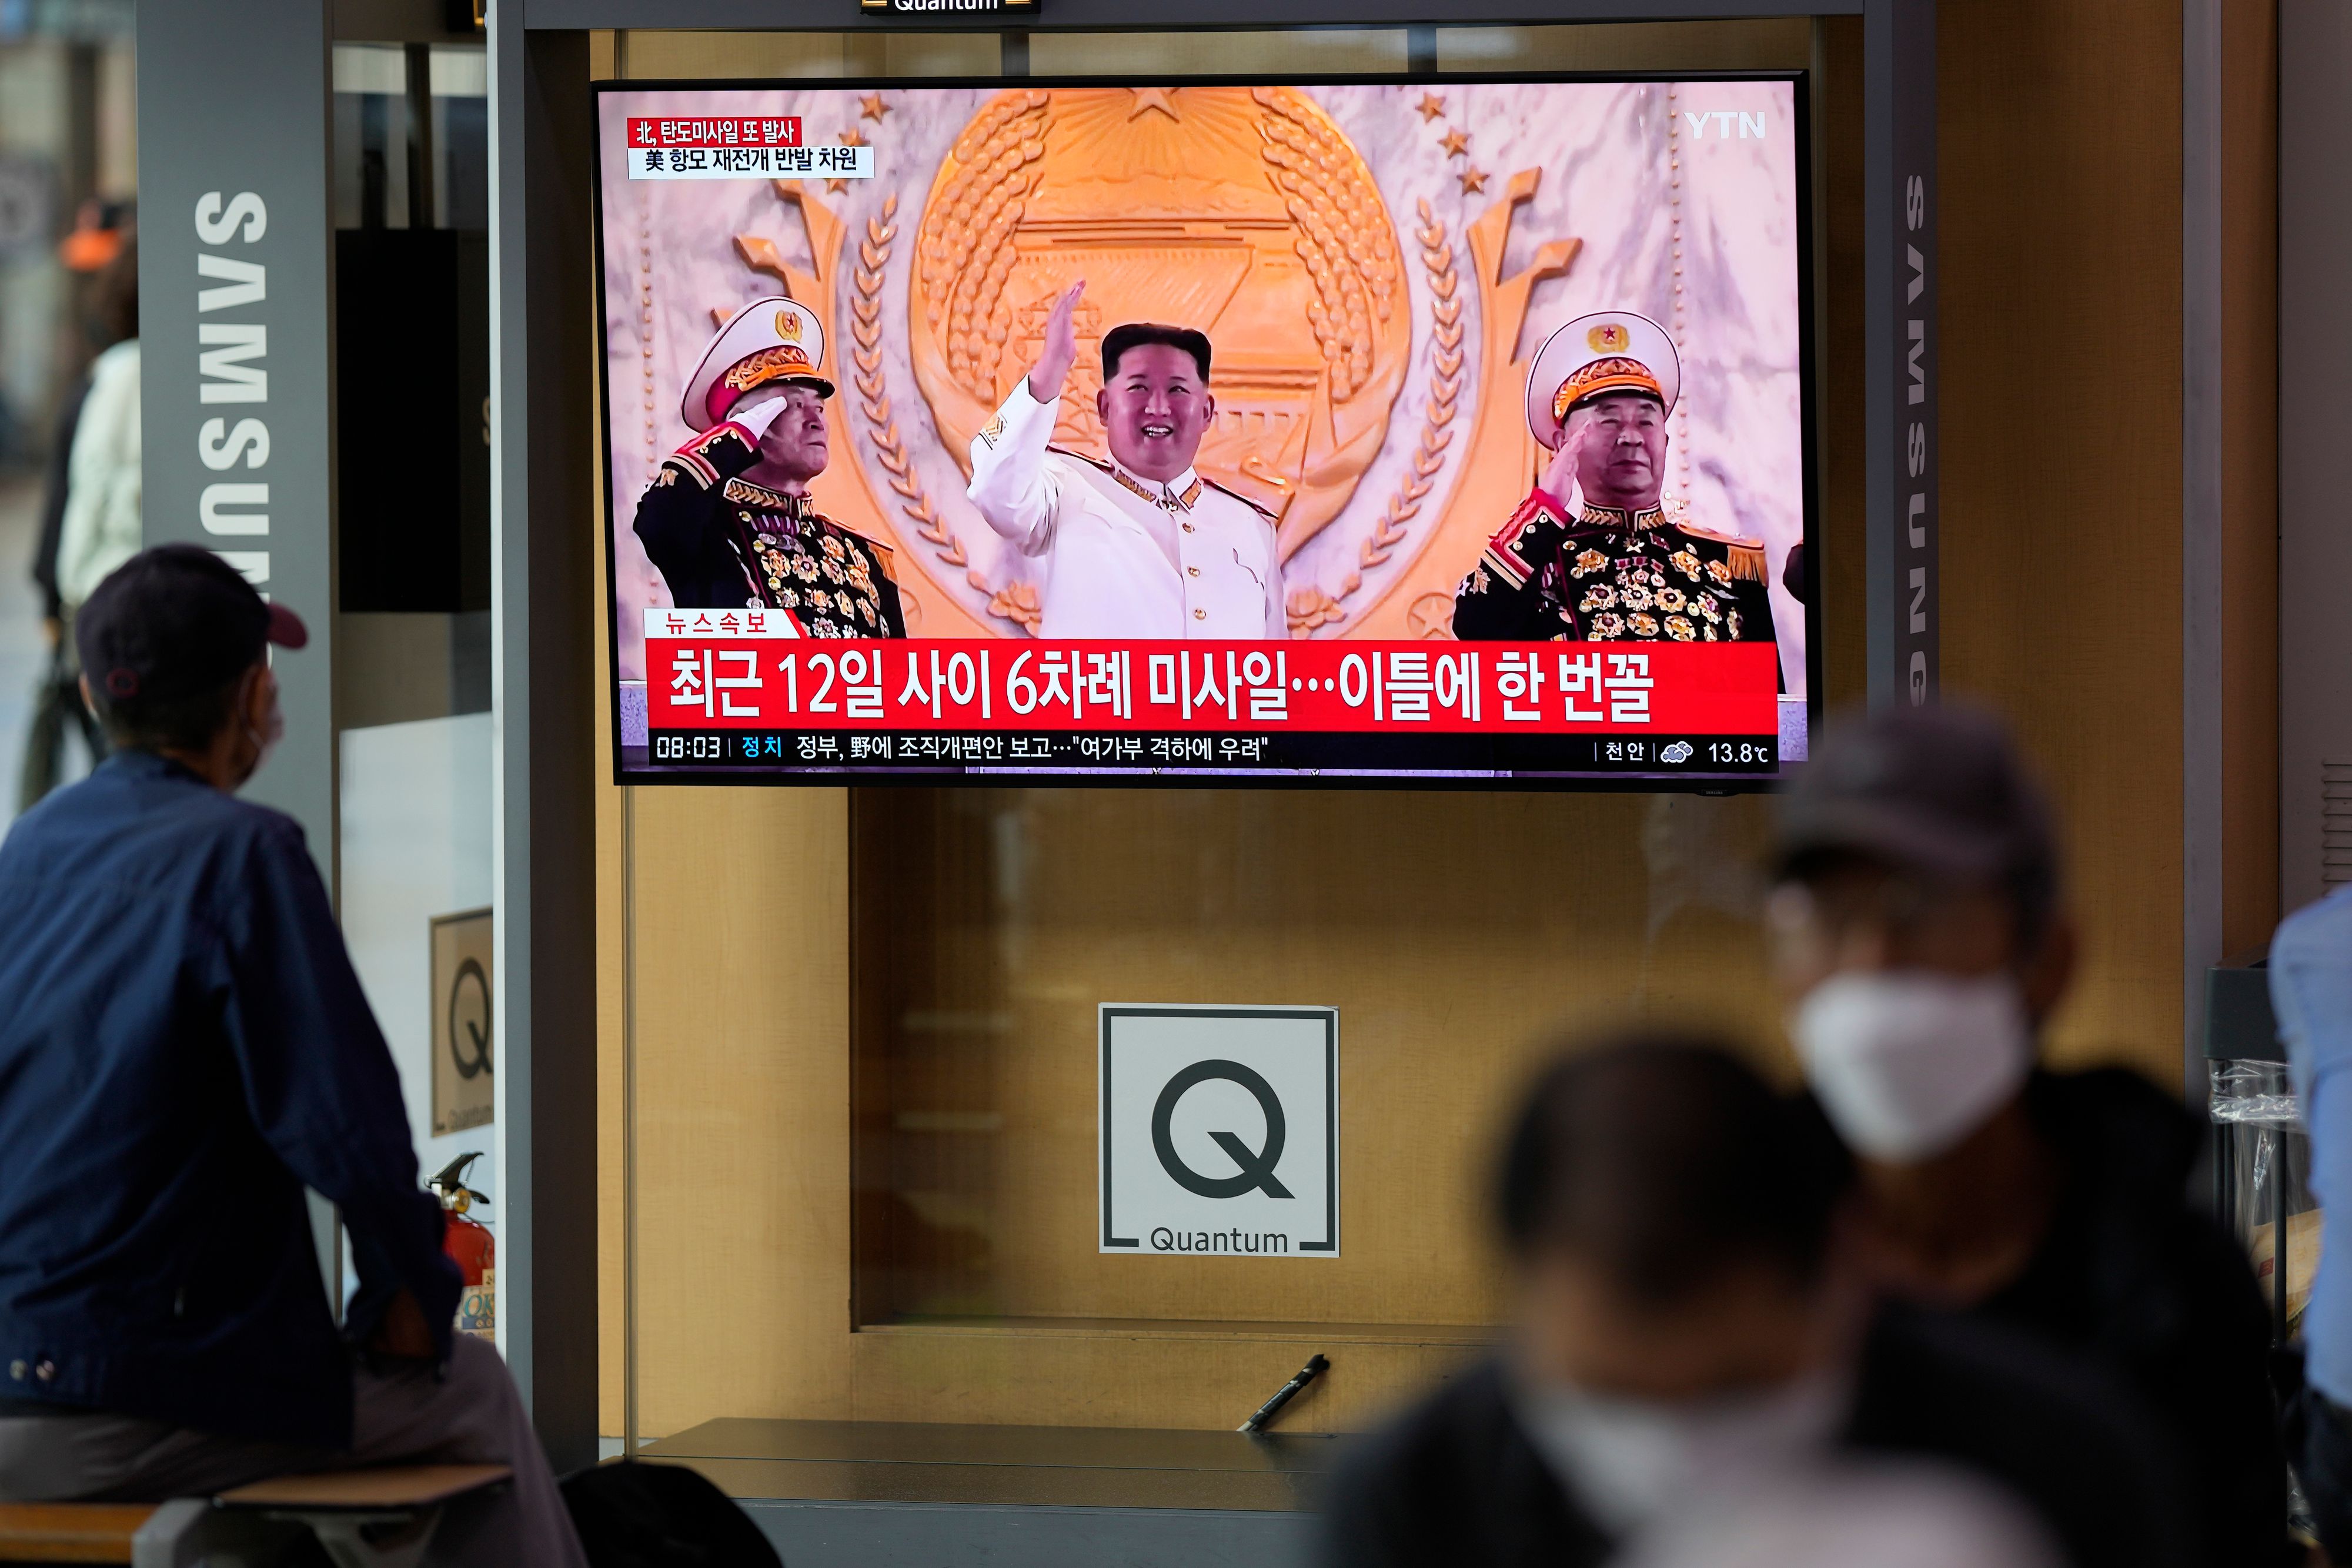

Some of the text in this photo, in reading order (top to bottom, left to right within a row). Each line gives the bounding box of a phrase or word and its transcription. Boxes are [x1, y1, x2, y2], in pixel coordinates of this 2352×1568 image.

[636, 120, 794, 146] 北, 탄도미사일 또 발사
[1683, 111, 1766, 139] YTN
[646, 148, 857, 172] 美 항모 재전개 반발 차원
[195, 191, 272, 669] SAMSU
[1906, 175, 1926, 707] SAMSUNG
[666, 613, 767, 635] 뉴스속보
[670, 649, 763, 718] 최근
[778, 649, 884, 718] 12일
[897, 650, 991, 718] 사이
[1006, 650, 1132, 719] 6차례
[1496, 651, 1545, 721] 한
[1558, 653, 1654, 723] 번꼴
[657, 736, 720, 758] 08:03
[742, 736, 782, 758] 정치
[797, 735, 844, 761] 정부,
[850, 735, 891, 759] 野에
[898, 736, 1004, 760] 조직개편안
[1150, 737, 1212, 761] 격하에
[1218, 737, 1268, 761] 우려"
[1605, 741, 1645, 761] 천안
[1151, 1059, 1296, 1199] Q
[1150, 1226, 1288, 1253] Quantum
